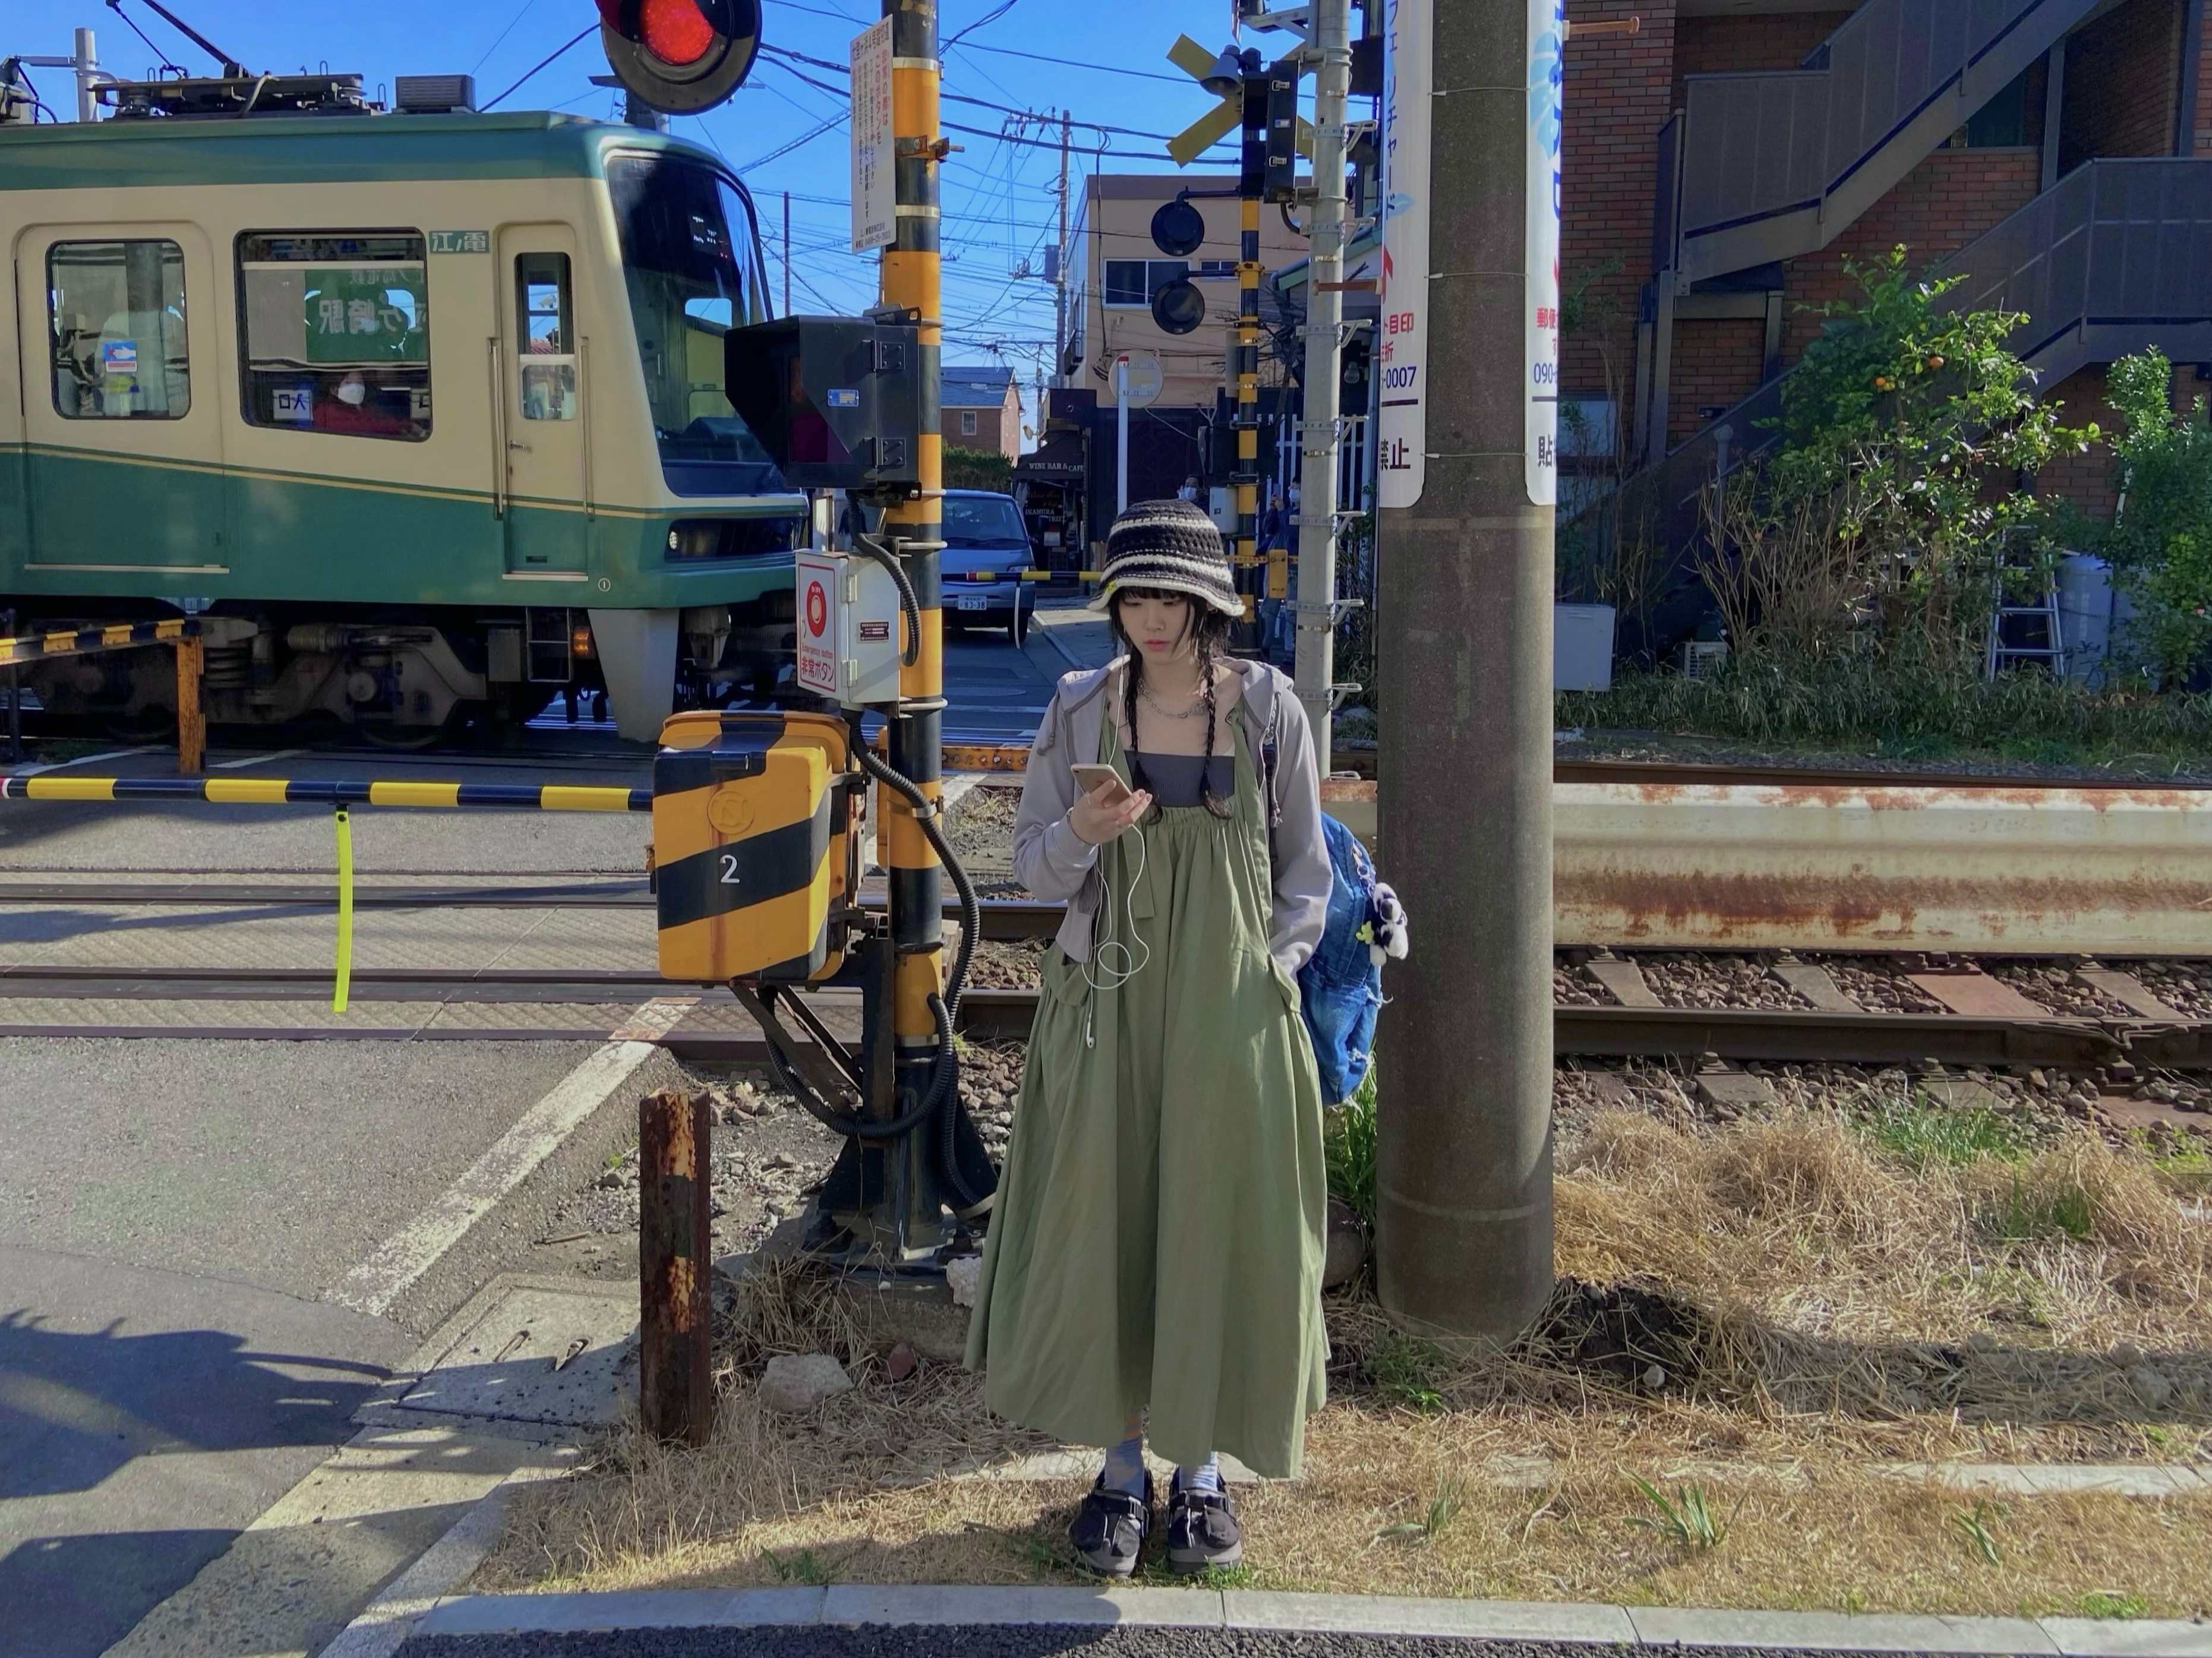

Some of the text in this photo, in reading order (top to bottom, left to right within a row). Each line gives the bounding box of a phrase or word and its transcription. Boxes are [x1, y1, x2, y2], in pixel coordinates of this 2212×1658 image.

[432, 232, 486, 252] 江ノ電
[1536, 308, 1557, 329] 郵便
[1537, 435, 1556, 468] 貼
[802, 656, 834, 683] 非常ボタン
[720, 854, 741, 883] 2
